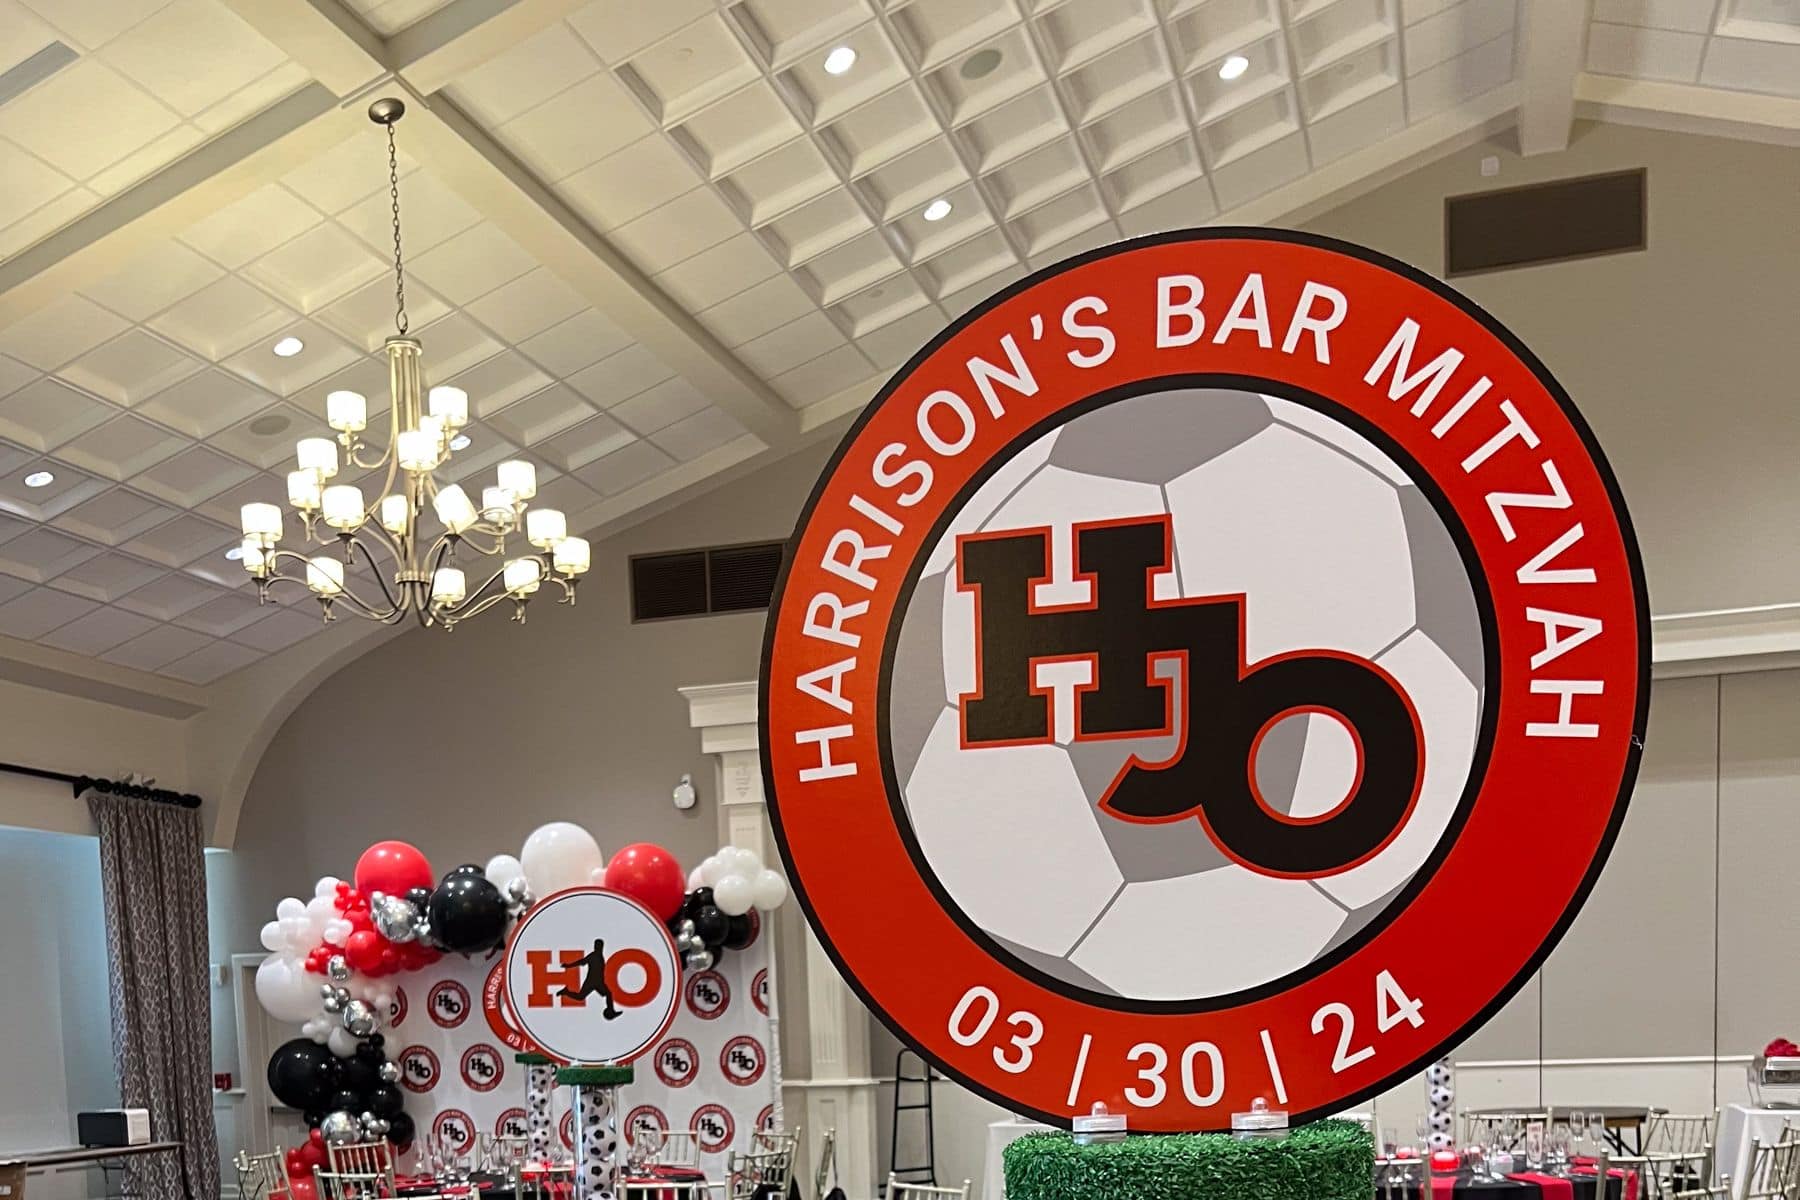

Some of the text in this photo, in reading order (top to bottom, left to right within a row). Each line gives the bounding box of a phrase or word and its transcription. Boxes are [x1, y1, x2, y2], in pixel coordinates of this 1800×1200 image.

[796, 274, 1603, 782] HARRISON'S BAR MITZVAH
[949, 987, 1043, 1073] 03
[1125, 1042, 1224, 1107] 30
[1311, 970, 1424, 1073] 24
